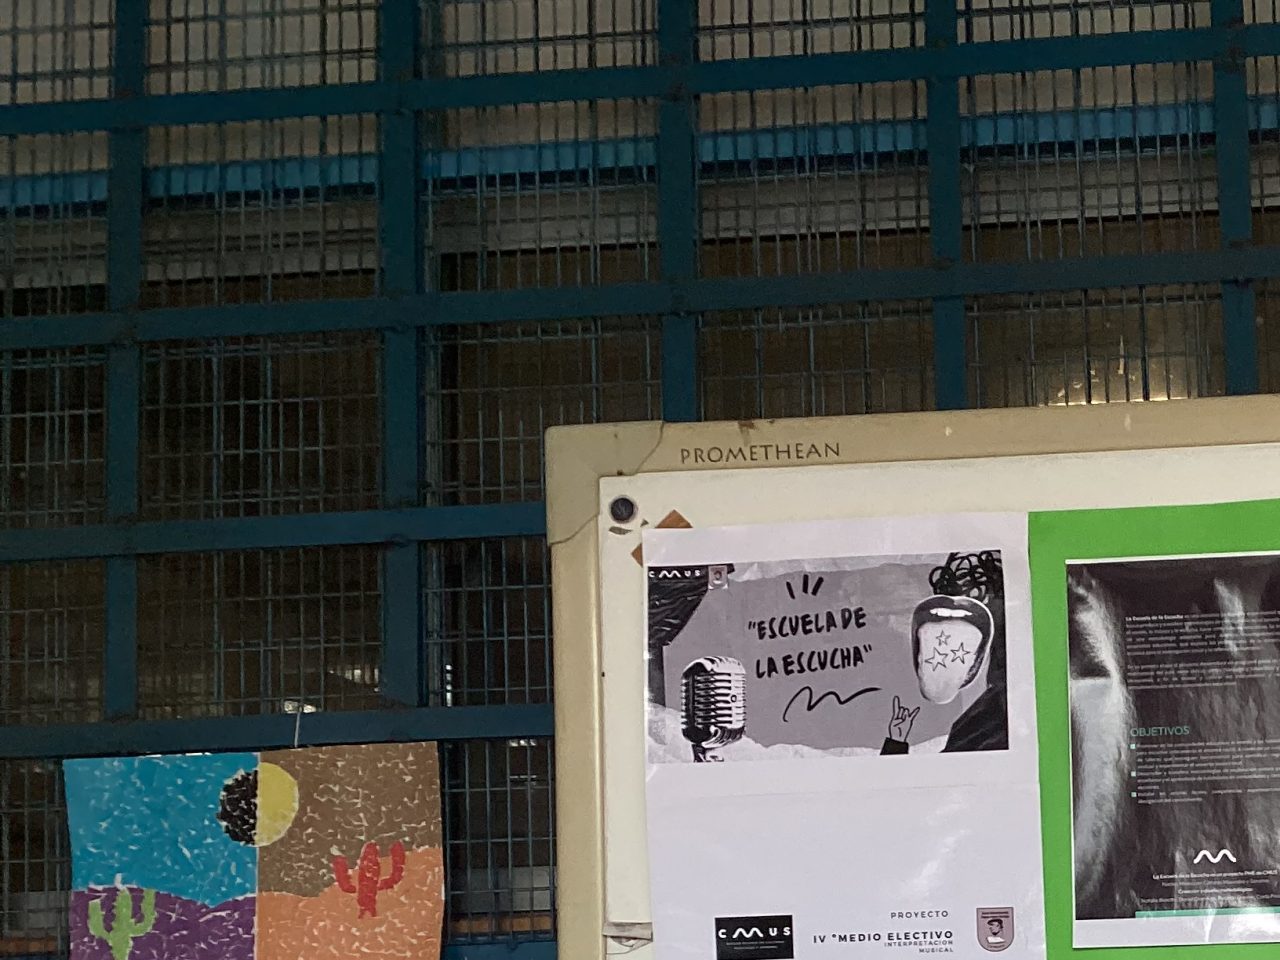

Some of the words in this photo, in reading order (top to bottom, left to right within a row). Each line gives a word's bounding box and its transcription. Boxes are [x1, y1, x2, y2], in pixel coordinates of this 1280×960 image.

[680, 442, 840, 464] PROMETHEAN
[748, 610, 837, 640] "ESCUELA
[841, 606, 867, 630] DE
[755, 656, 779, 679] LA
[782, 643, 873, 676] ESCUCHA"
[1130, 725, 1190, 737] OBJETIVOS
[890, 910, 949, 919] PROYECTO
[813, 935, 826, 943] IV
[887, 930, 953, 941] ELECTIVO
